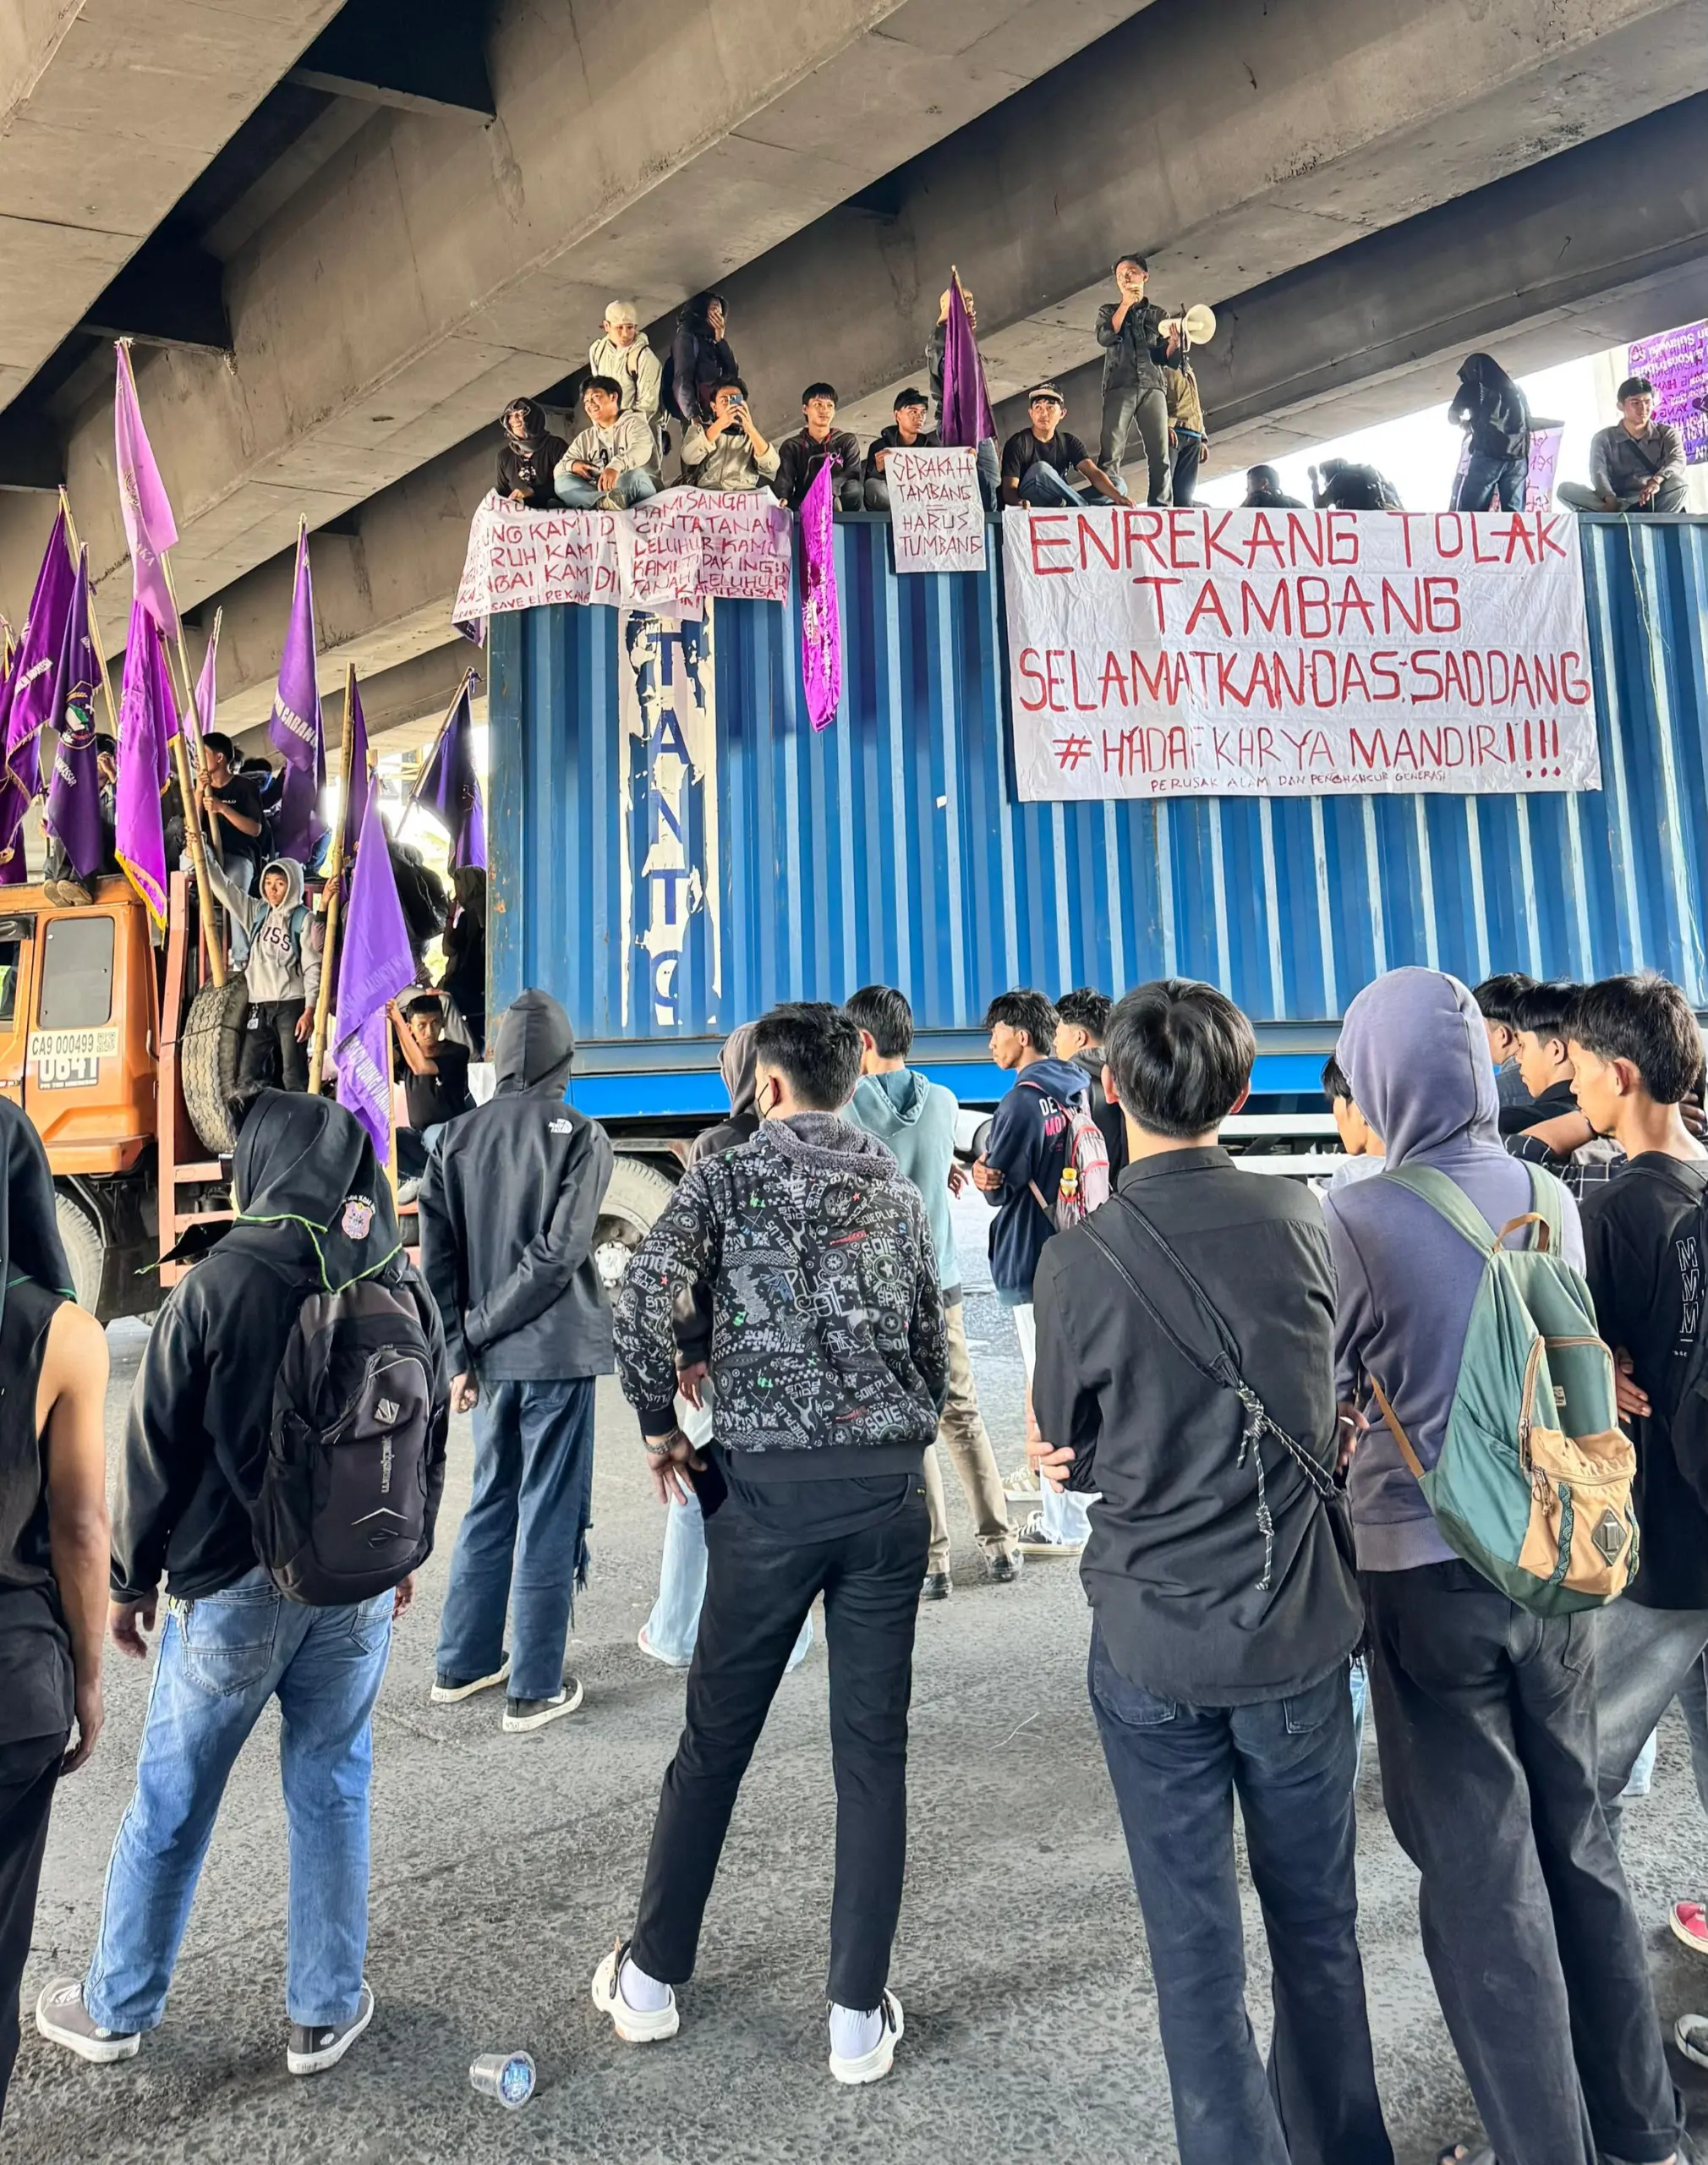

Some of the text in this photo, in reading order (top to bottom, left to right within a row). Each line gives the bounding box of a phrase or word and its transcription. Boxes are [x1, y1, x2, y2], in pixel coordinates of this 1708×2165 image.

[893, 452, 973, 482] SERAKAH
[686, 491, 768, 512] SANGAT
[897, 483, 972, 502] TAMBANG
[529, 516, 590, 541] KAMI
[636, 515, 703, 534] CINTA
[902, 512, 969, 532] HARUS
[545, 543, 599, 562] KAMI
[634, 537, 714, 557] LELUHUR
[900, 535, 983, 557] TUMBANG
[1030, 509, 1568, 575] ENREKANG TOLAK
[634, 559, 678, 577] KAMI
[682, 553, 734, 572] TIDAK
[698, 568, 786, 590] LELUHUR
[491, 597, 525, 611] SAVE
[1132, 575, 1462, 639] TAMBANG
[1150, 777, 1218, 793] PERUSAK
[1227, 776, 1269, 790] ALAM
[1278, 773, 1306, 787] DAN
[1394, 770, 1447, 784] GENERASI
[31, 1033, 95, 1056] CA9 000499
[862, 1237, 897, 1258] SOIE
[865, 1405, 903, 1433] SOIE
